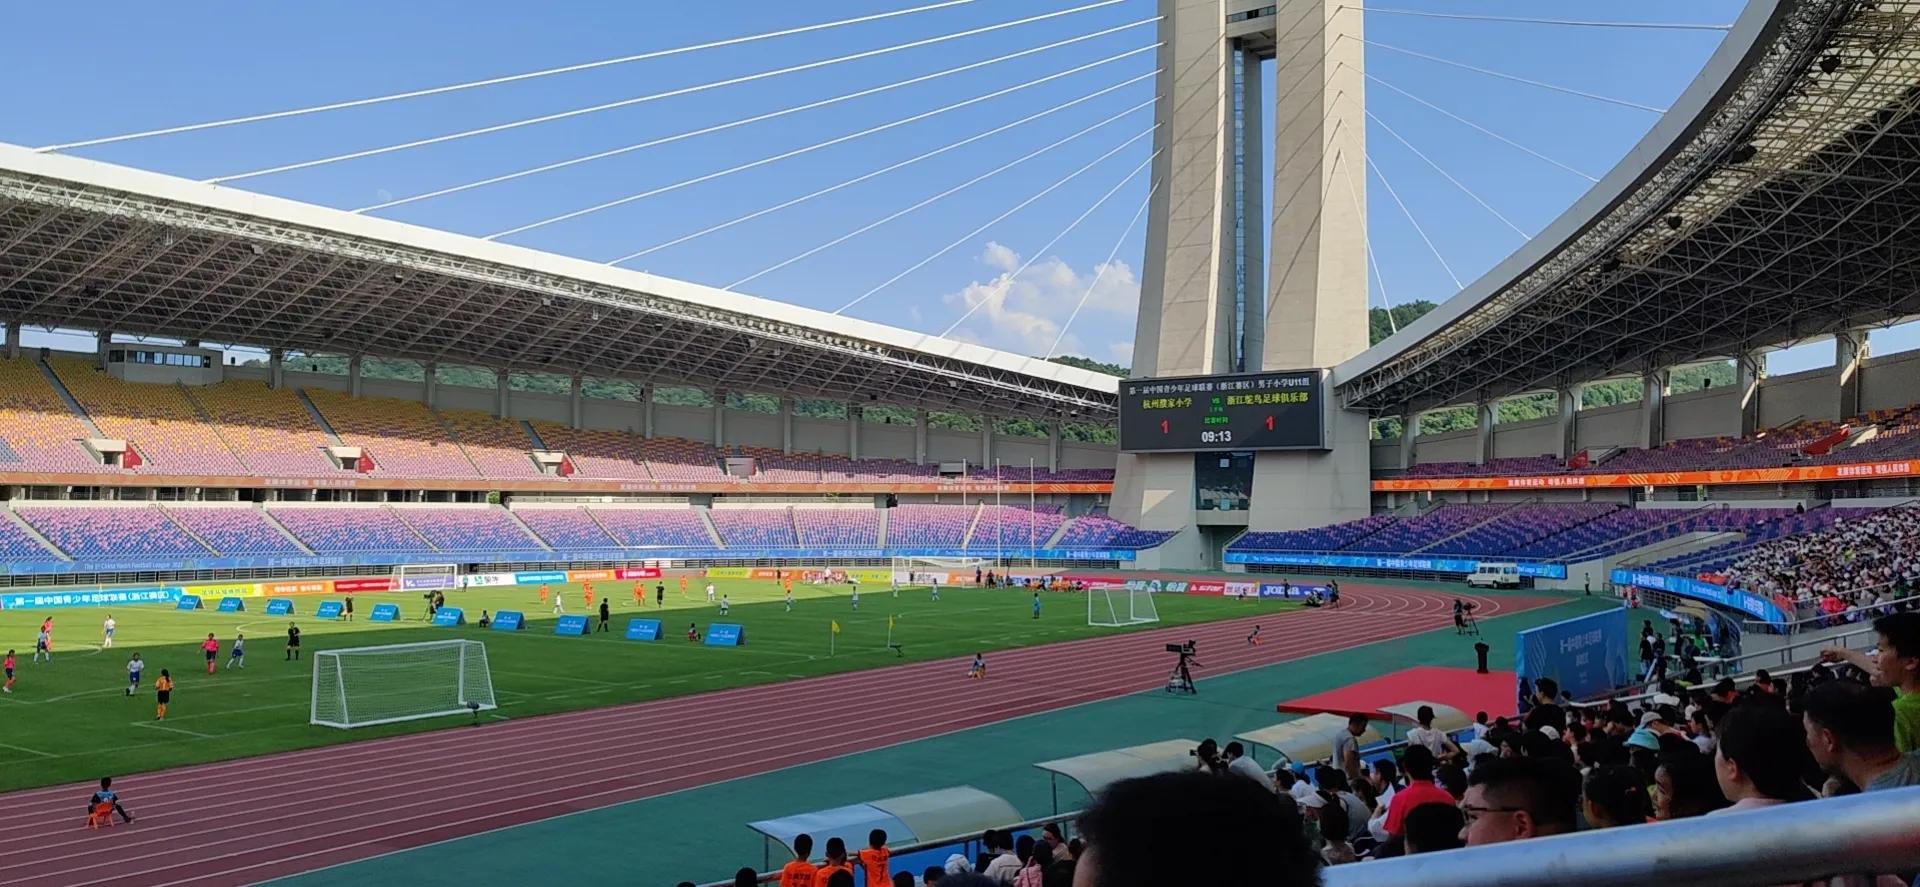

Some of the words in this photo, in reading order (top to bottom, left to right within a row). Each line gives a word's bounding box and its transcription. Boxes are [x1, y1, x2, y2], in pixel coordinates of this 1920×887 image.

[1161, 419, 1169, 434] 1
[1265, 415, 1274, 431] 1
[1201, 430, 1232, 443] 09:13
